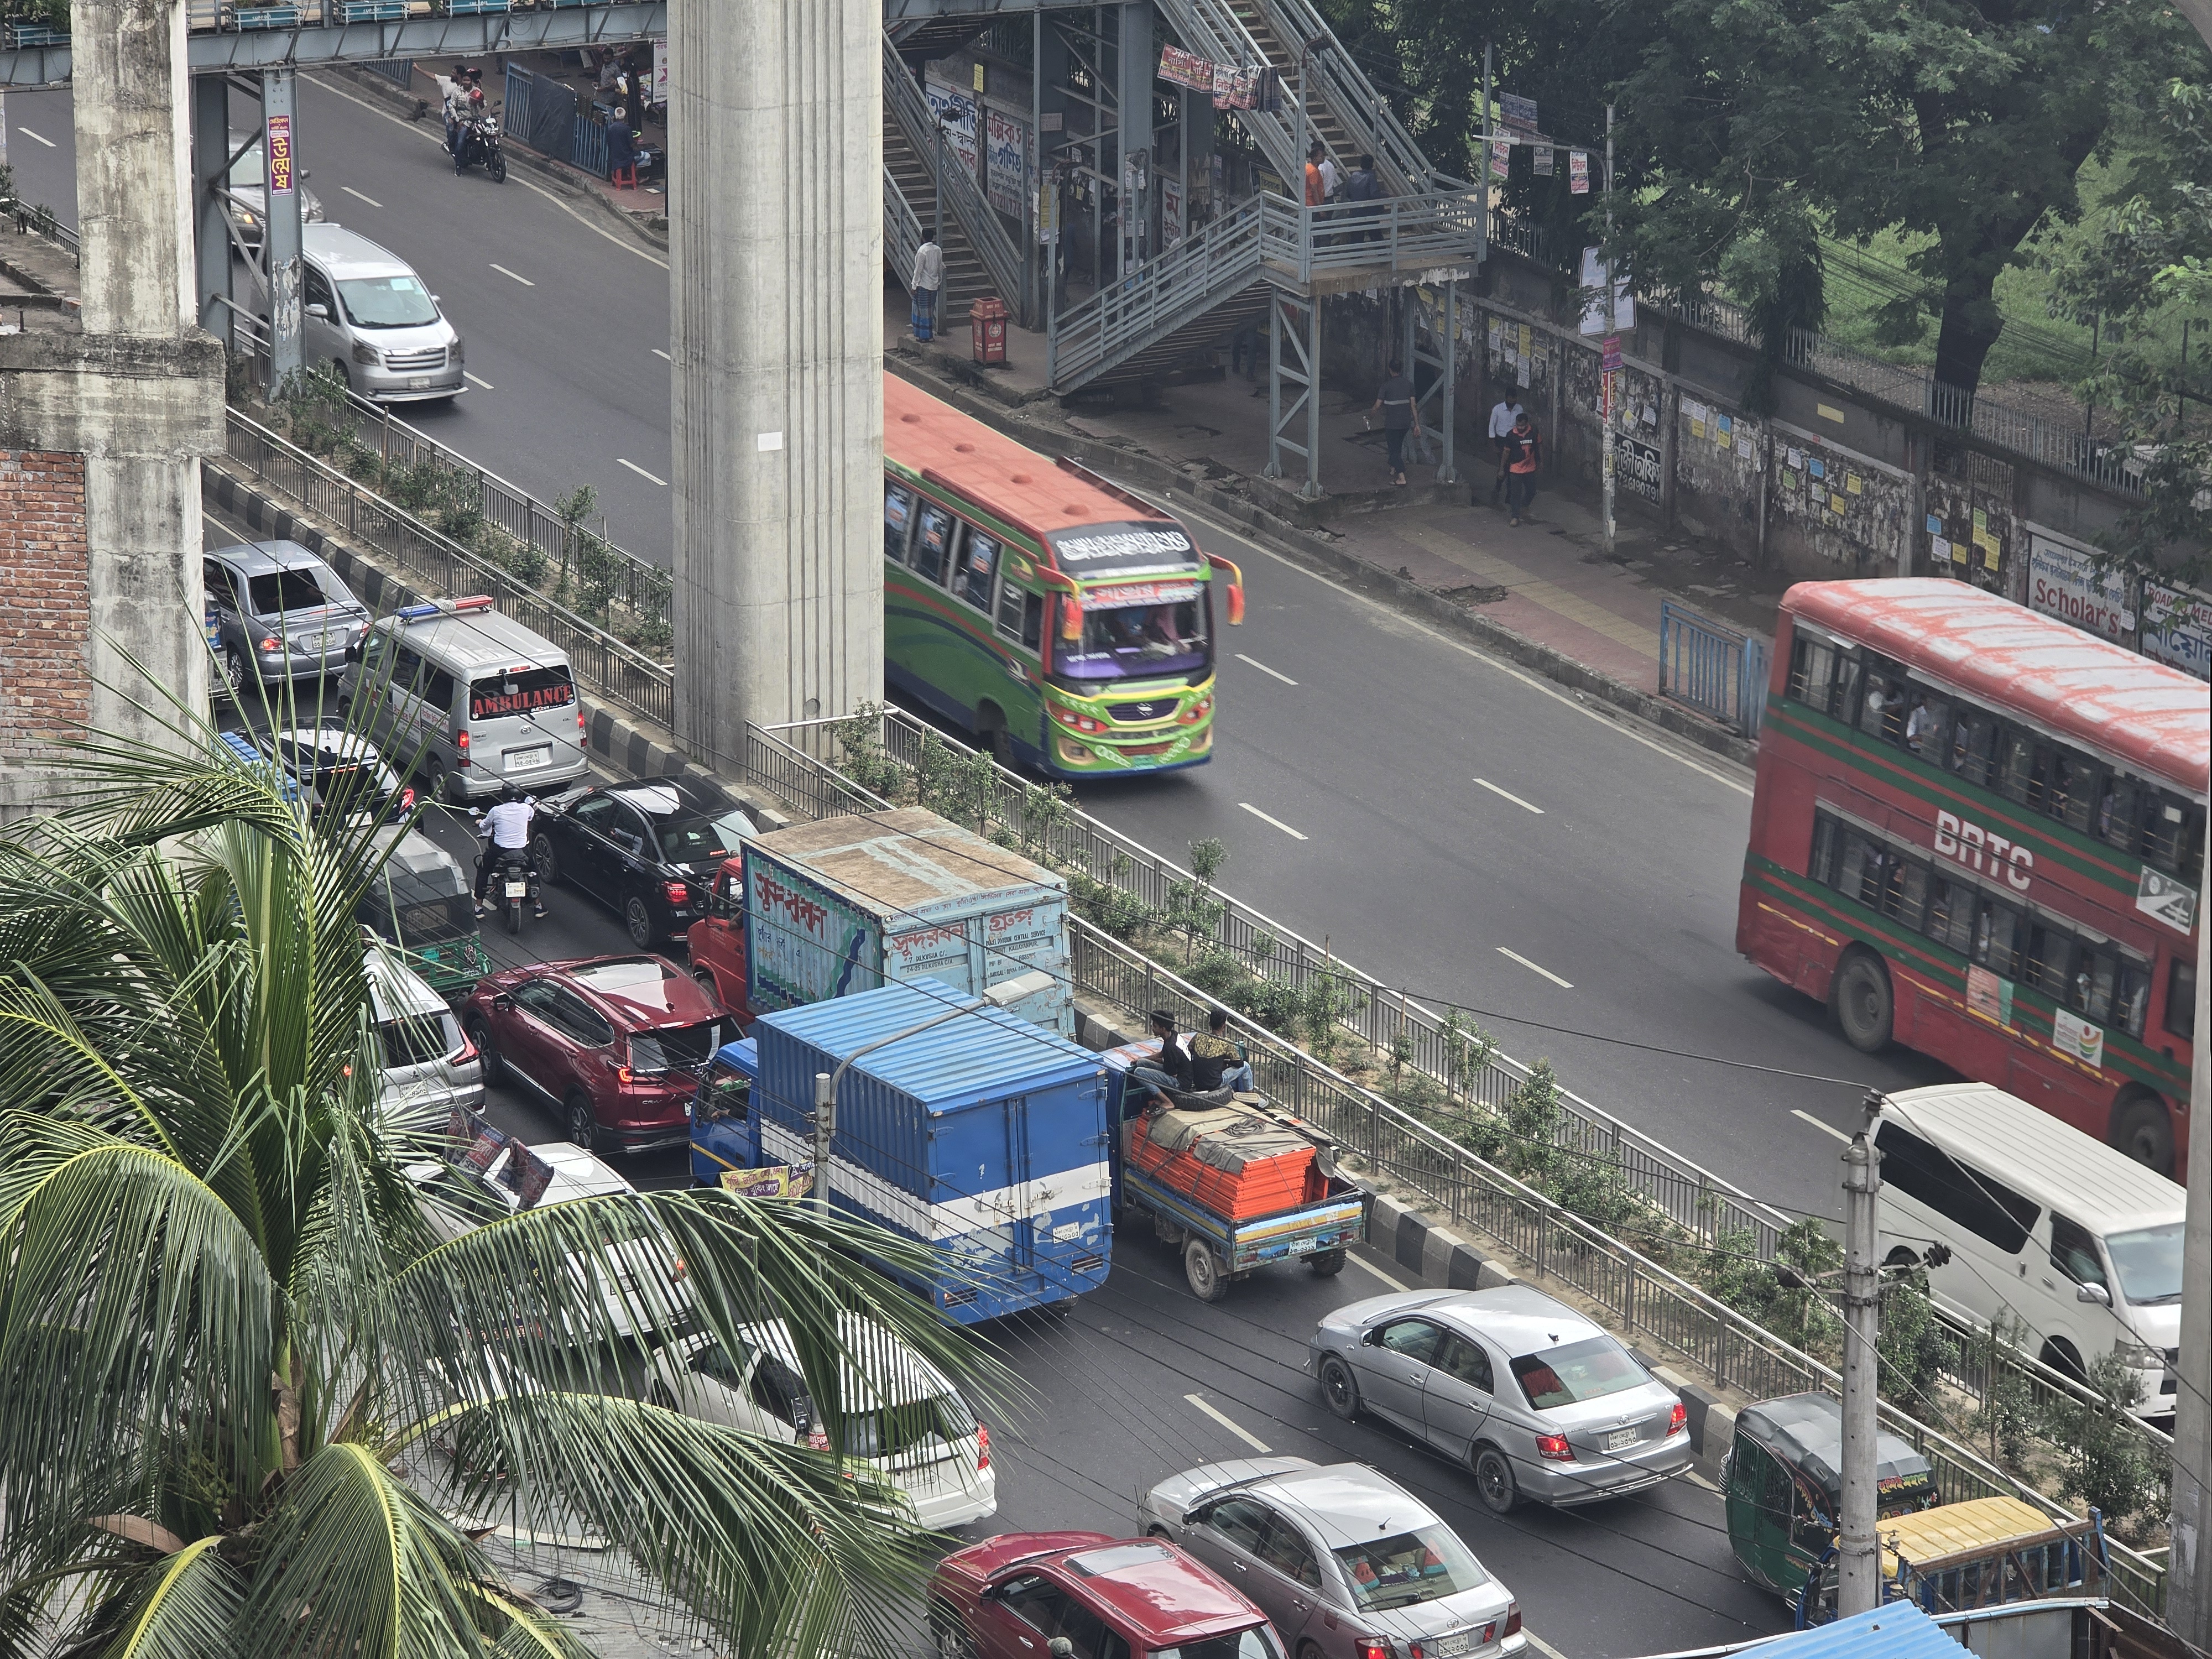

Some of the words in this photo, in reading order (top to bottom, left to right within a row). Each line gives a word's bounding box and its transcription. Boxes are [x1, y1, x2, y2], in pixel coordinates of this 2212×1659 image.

[998, 142, 1021, 173] গণিত
[1618, 470, 1659, 502] 726190391
[2034, 578, 2119, 634] Scholar's
[474, 685, 571, 715] AMBULANCE
[1935, 809, 2034, 891] BRTC
[891, 922, 966, 962] সুন্দরবন
[1014, 933, 1029, 941] CENTRAL
[1031, 930, 1046, 938] SERVICE
[916, 952, 938, 962] DILKUSHA
[921, 960, 944, 970] DILKUSHA
